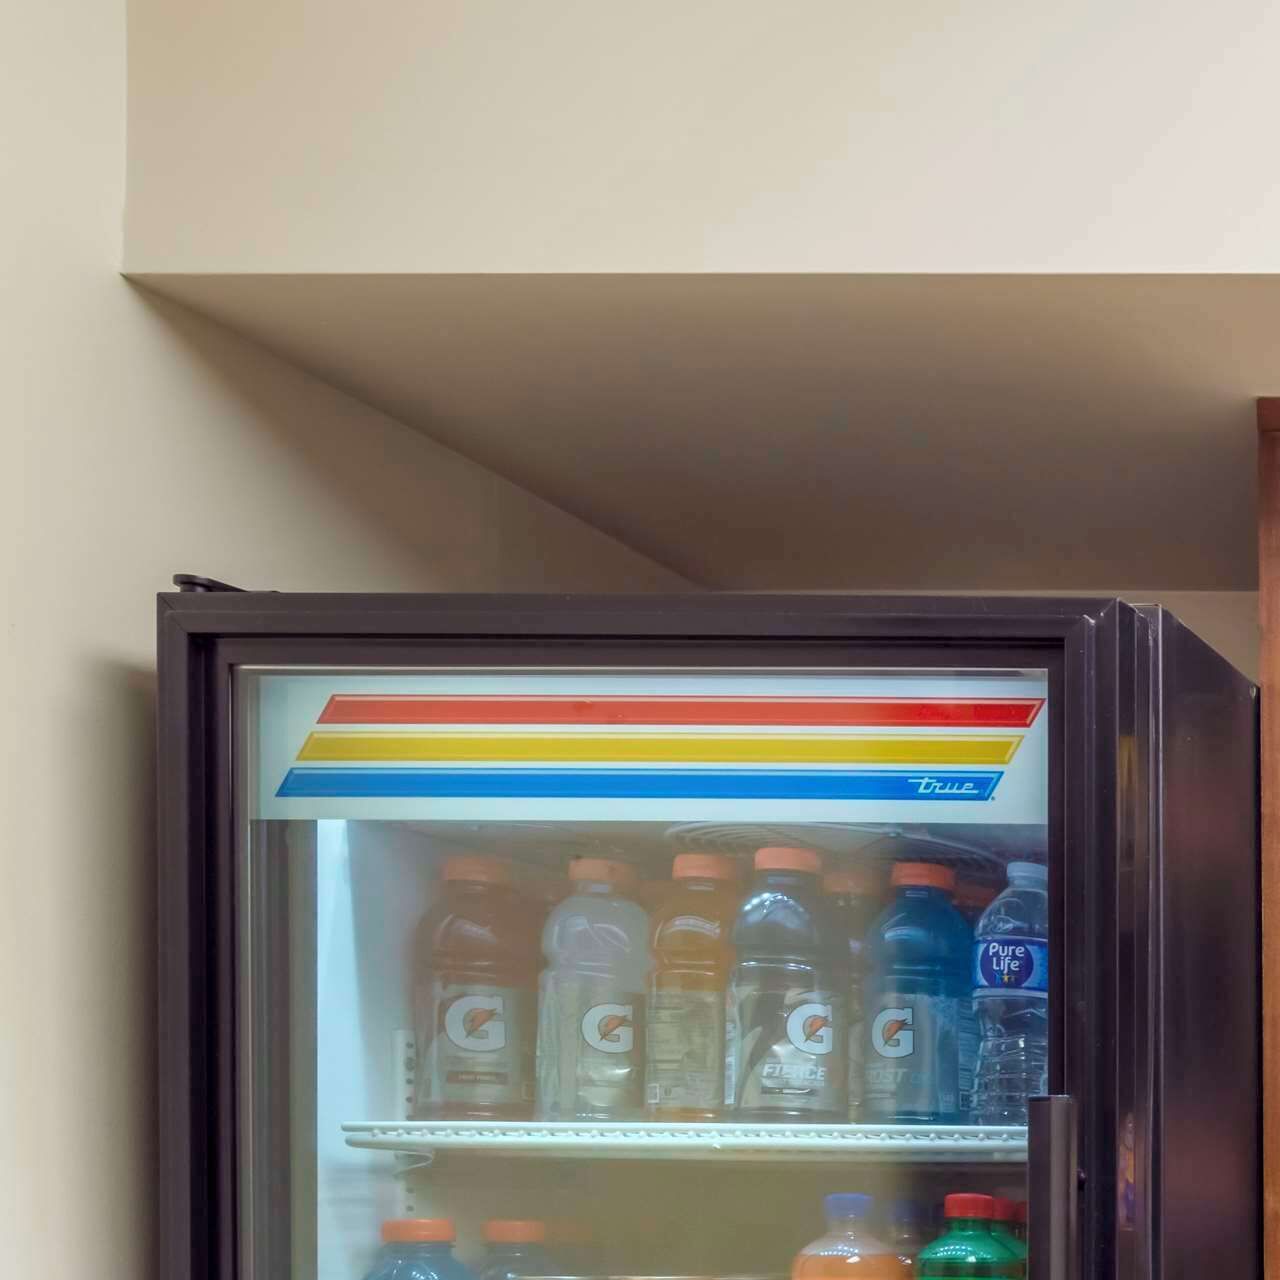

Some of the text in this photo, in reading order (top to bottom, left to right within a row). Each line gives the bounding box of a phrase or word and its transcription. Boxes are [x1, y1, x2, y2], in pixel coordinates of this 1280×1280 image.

[988, 942, 1026, 959] Pure
[992, 957, 1021, 975] Life
[444, 995, 506, 1051] G
[581, 1003, 633, 1053] G
[785, 1003, 833, 1055] G
[871, 1008, 915, 1058] G
